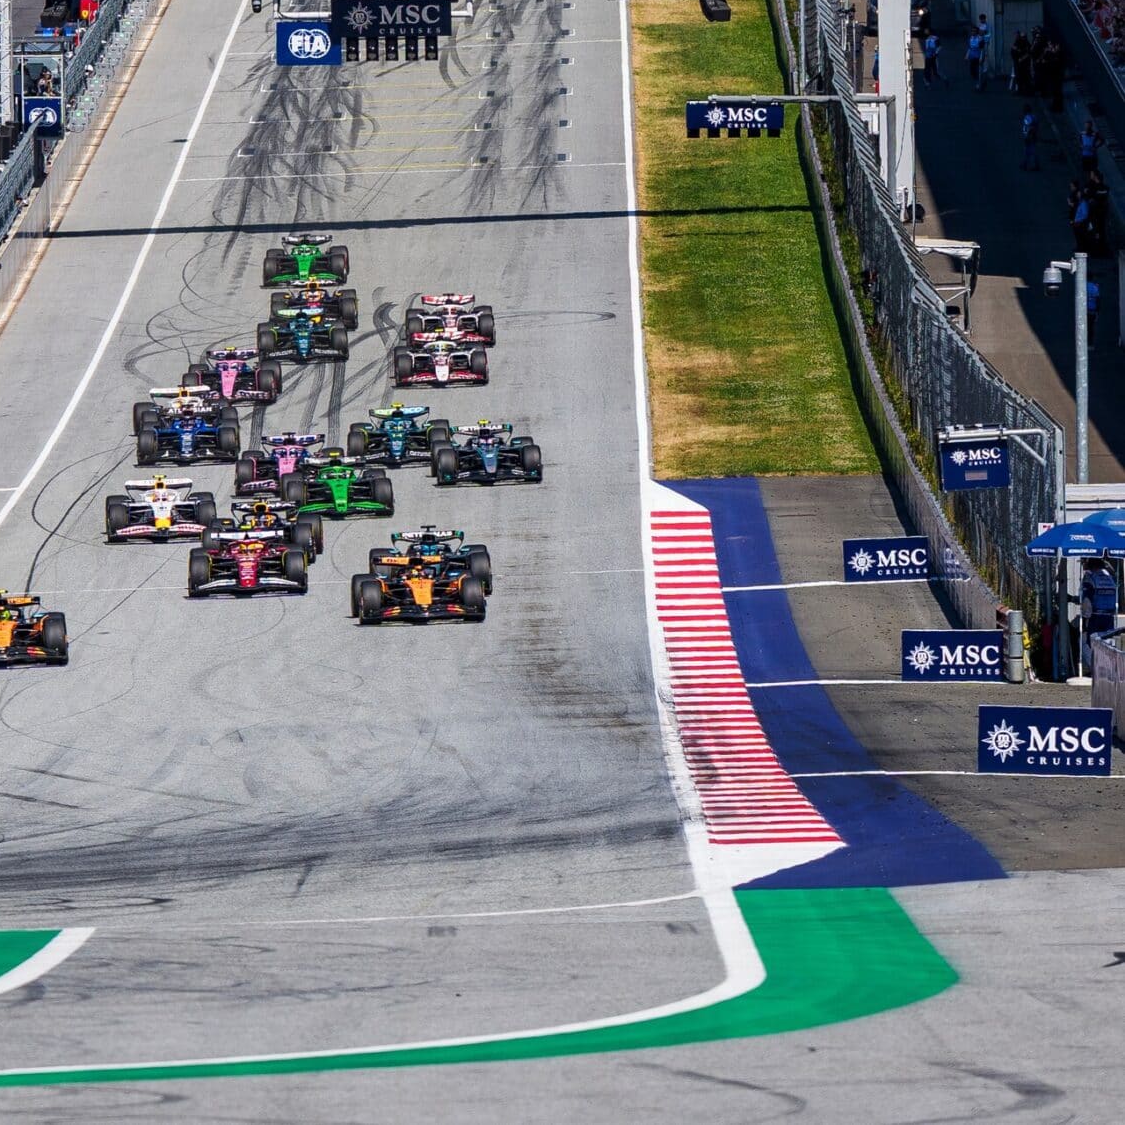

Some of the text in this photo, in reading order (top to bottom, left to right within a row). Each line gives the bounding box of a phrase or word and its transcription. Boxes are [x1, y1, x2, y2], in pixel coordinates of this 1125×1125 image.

[379, 4, 441, 25] MSC
[727, 108, 767, 122] MSC
[968, 447, 1001, 461] MSC
[876, 549, 927, 567] MSC
[939, 645, 1000, 665] MSC
[1026, 726, 1105, 754] MSC
[1026, 757, 1105, 766] CRUISES
